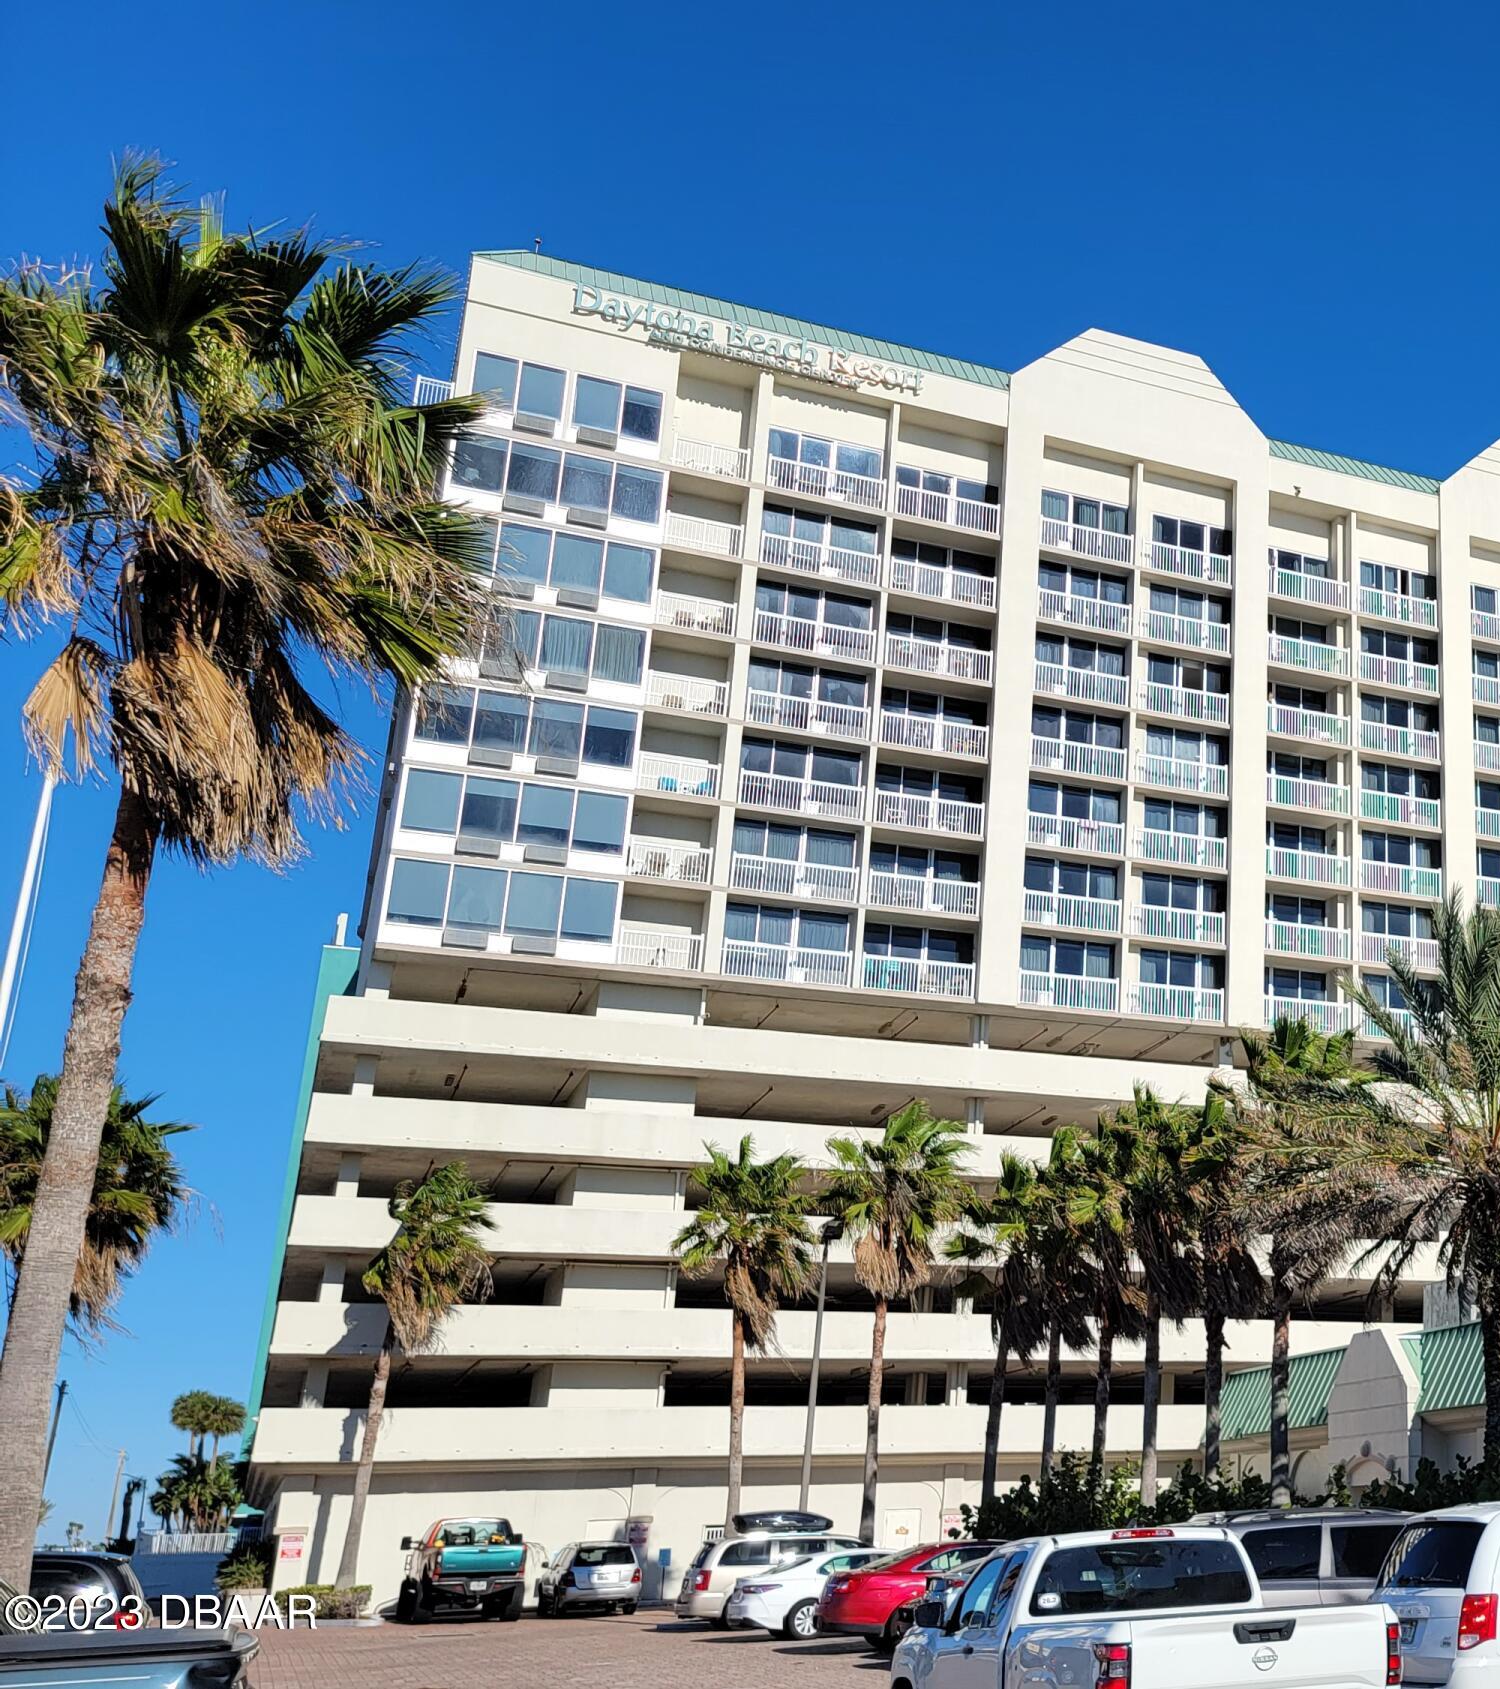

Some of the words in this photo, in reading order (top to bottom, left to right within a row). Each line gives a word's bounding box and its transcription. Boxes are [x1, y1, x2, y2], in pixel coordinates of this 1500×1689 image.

[573, 281, 714, 340] Daytona
[727, 320, 819, 366] Beach
[830, 346, 924, 391] Resort
[649, 331, 684, 346] AND
[688, 339, 796, 373] CONFERENCE
[800, 366, 863, 389] CENTER
